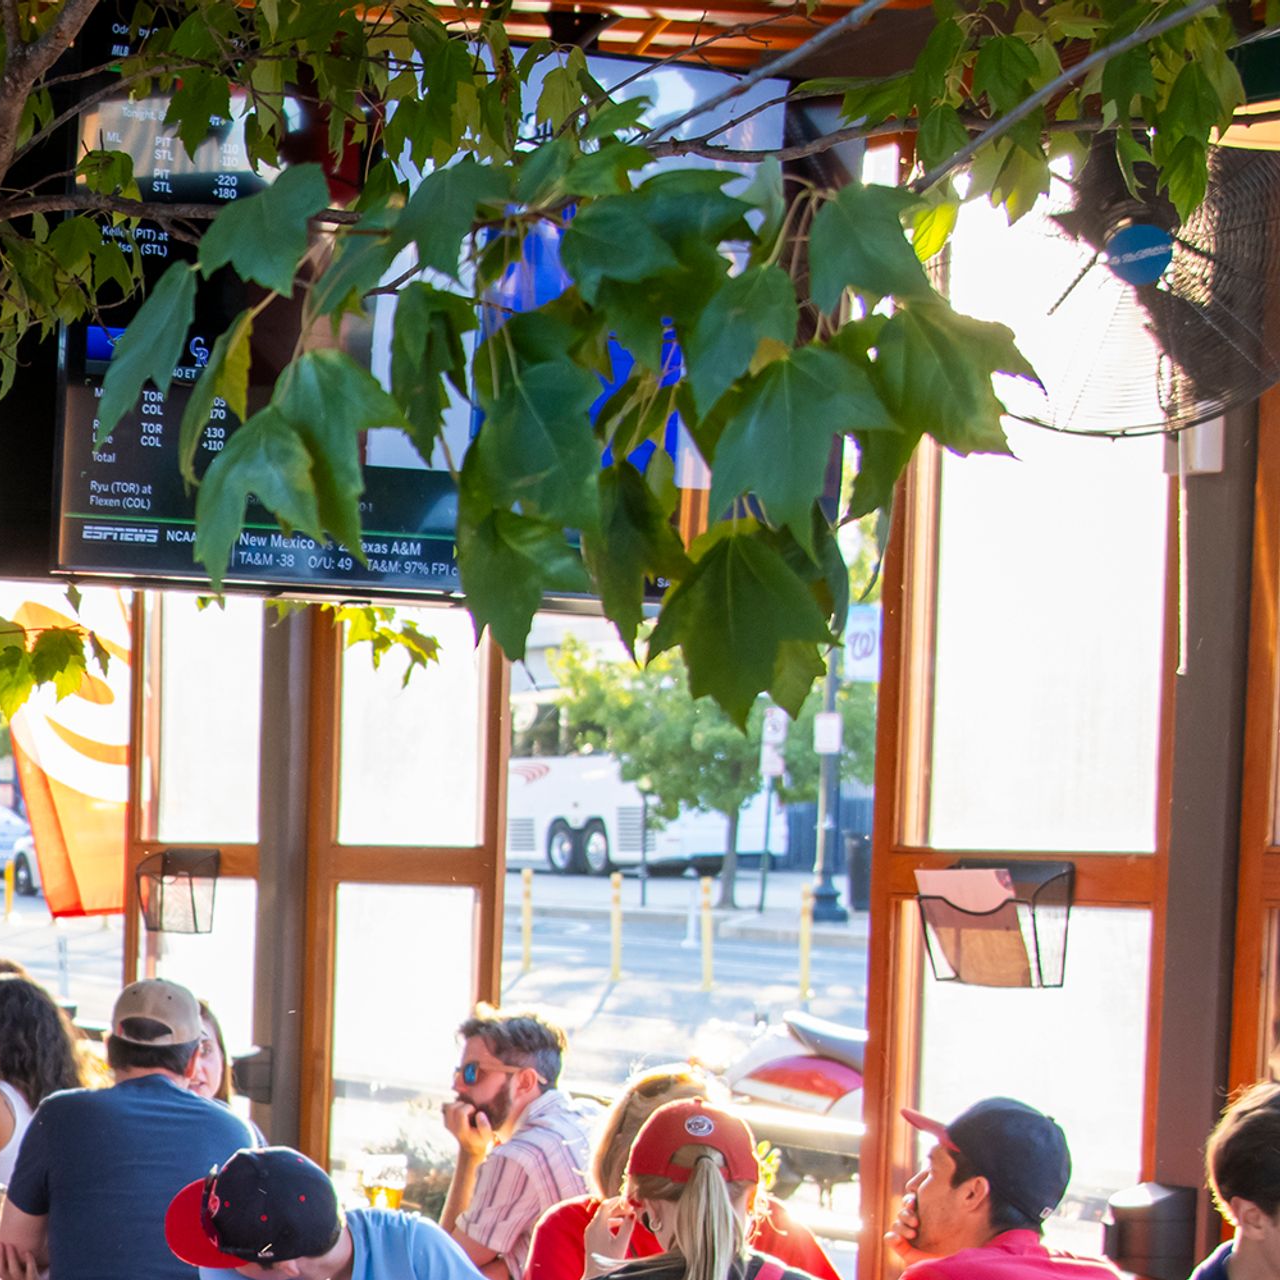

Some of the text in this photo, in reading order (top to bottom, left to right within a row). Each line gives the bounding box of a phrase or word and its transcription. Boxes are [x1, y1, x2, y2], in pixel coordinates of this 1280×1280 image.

[111, 45, 129, 57] MLB
[106, 132, 122, 143] ML
[155, 136, 172, 148] PIT
[154, 149, 174, 161] STL
[153, 168, 237, 187] PIT -220
[152, 181, 237, 199] STL +180
[132, 228, 157, 241] (PIT)
[158, 230, 169, 241] at
[141, 244, 168, 258] (STL)
[184, 369, 197, 379] ET
[142, 390, 164, 402] TOR
[142, 404, 226, 420] COL 170
[141, 422, 225, 438] TOR -130
[140, 435, 162, 447] COL
[202, 440, 224, 451] +110
[92, 451, 116, 463] Total
[90, 480, 152, 496] Ryu (TOR) at
[89, 495, 151, 511] Flexen (COL)
[82, 525, 159, 543] ESPNEWS
[239, 533, 267, 547] New
[270, 534, 316, 550] Mexico
[359, 541, 388, 555] exas
[390, 542, 422, 556] A&M
[239, 552, 273, 567] TA&M
[275, 555, 295, 568] -38
[307, 556, 335, 570] O/U:
[337, 558, 353, 572] 49
[366, 559, 402, 574] TA&M:
[403, 561, 430, 576] 97%
[431, 562, 450, 577] FPI
